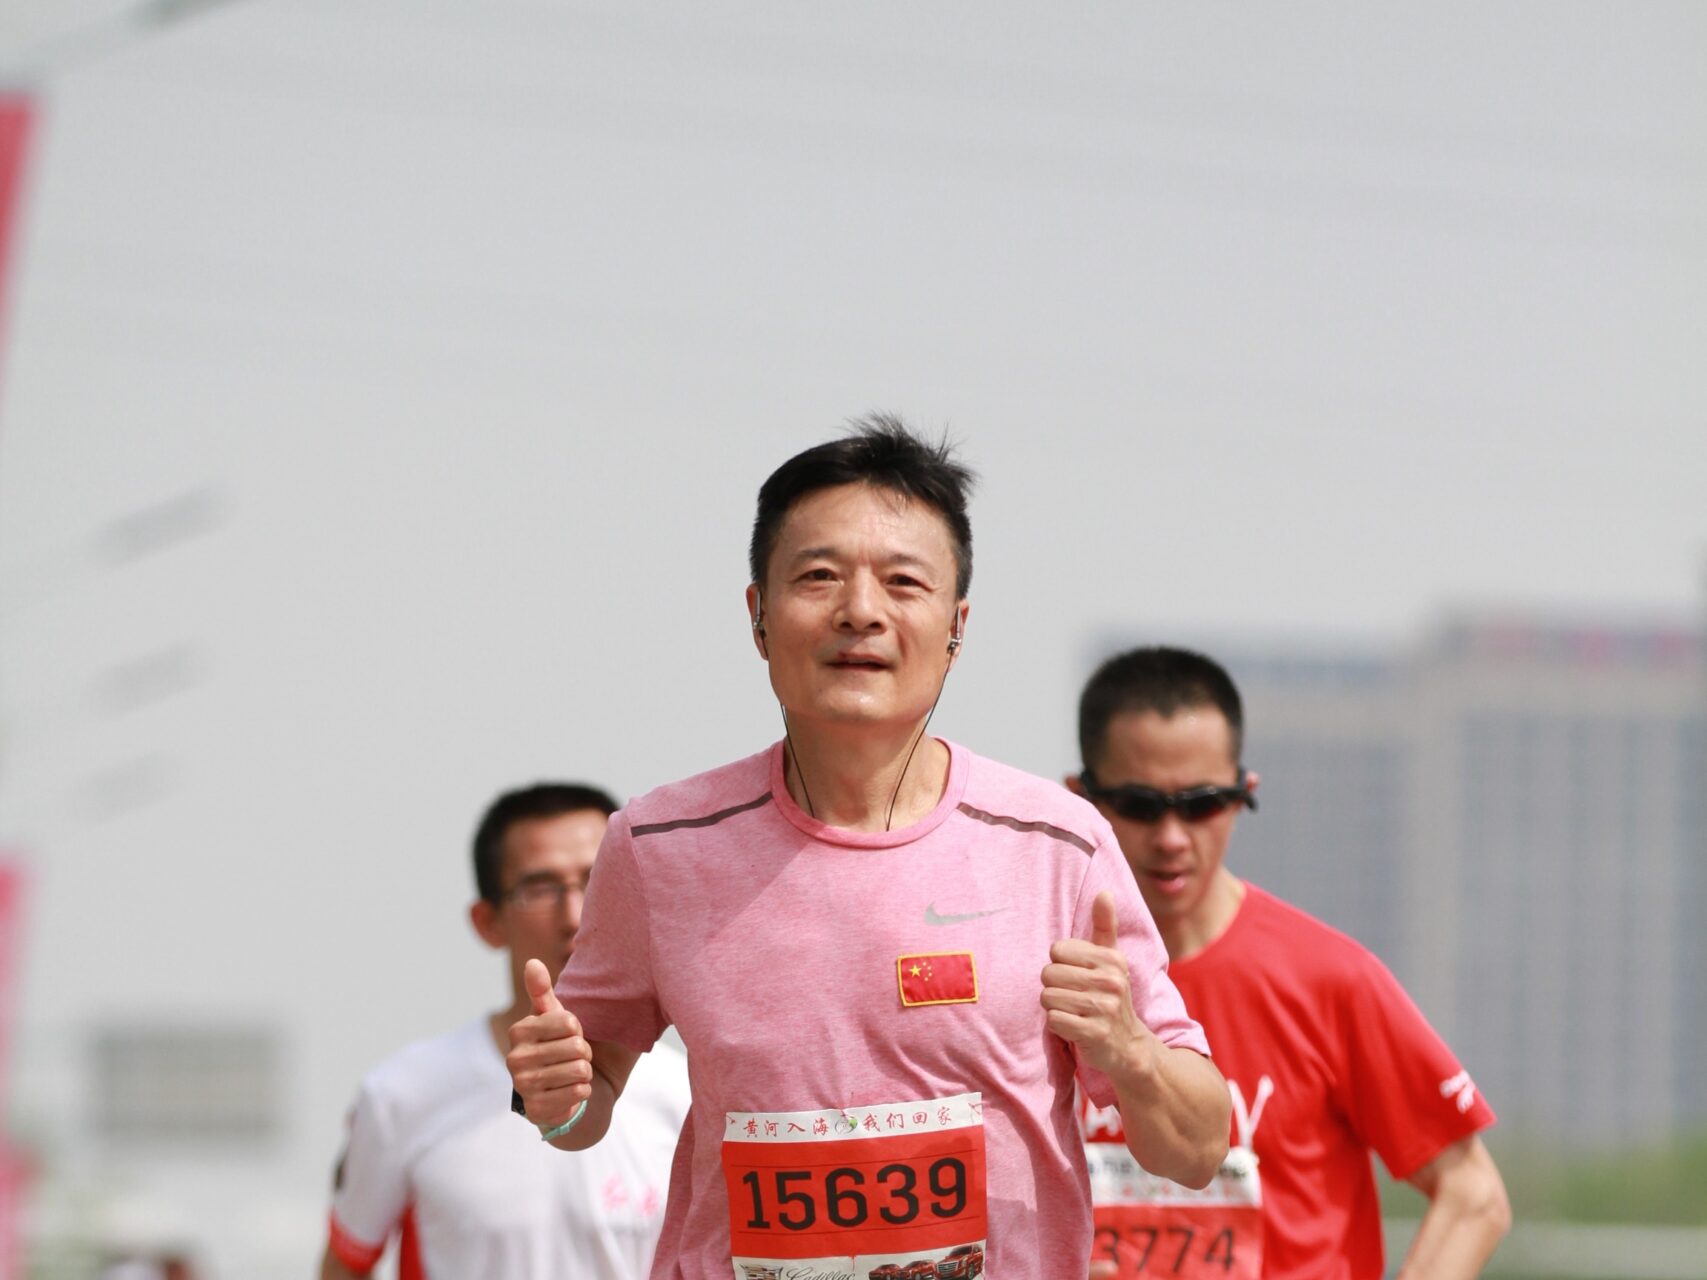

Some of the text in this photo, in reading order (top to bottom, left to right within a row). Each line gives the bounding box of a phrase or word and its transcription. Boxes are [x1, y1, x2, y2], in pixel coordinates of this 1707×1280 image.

[743, 1106, 953, 1138] 黄河入海 我们回家
[742, 1157, 968, 1231] 15639
